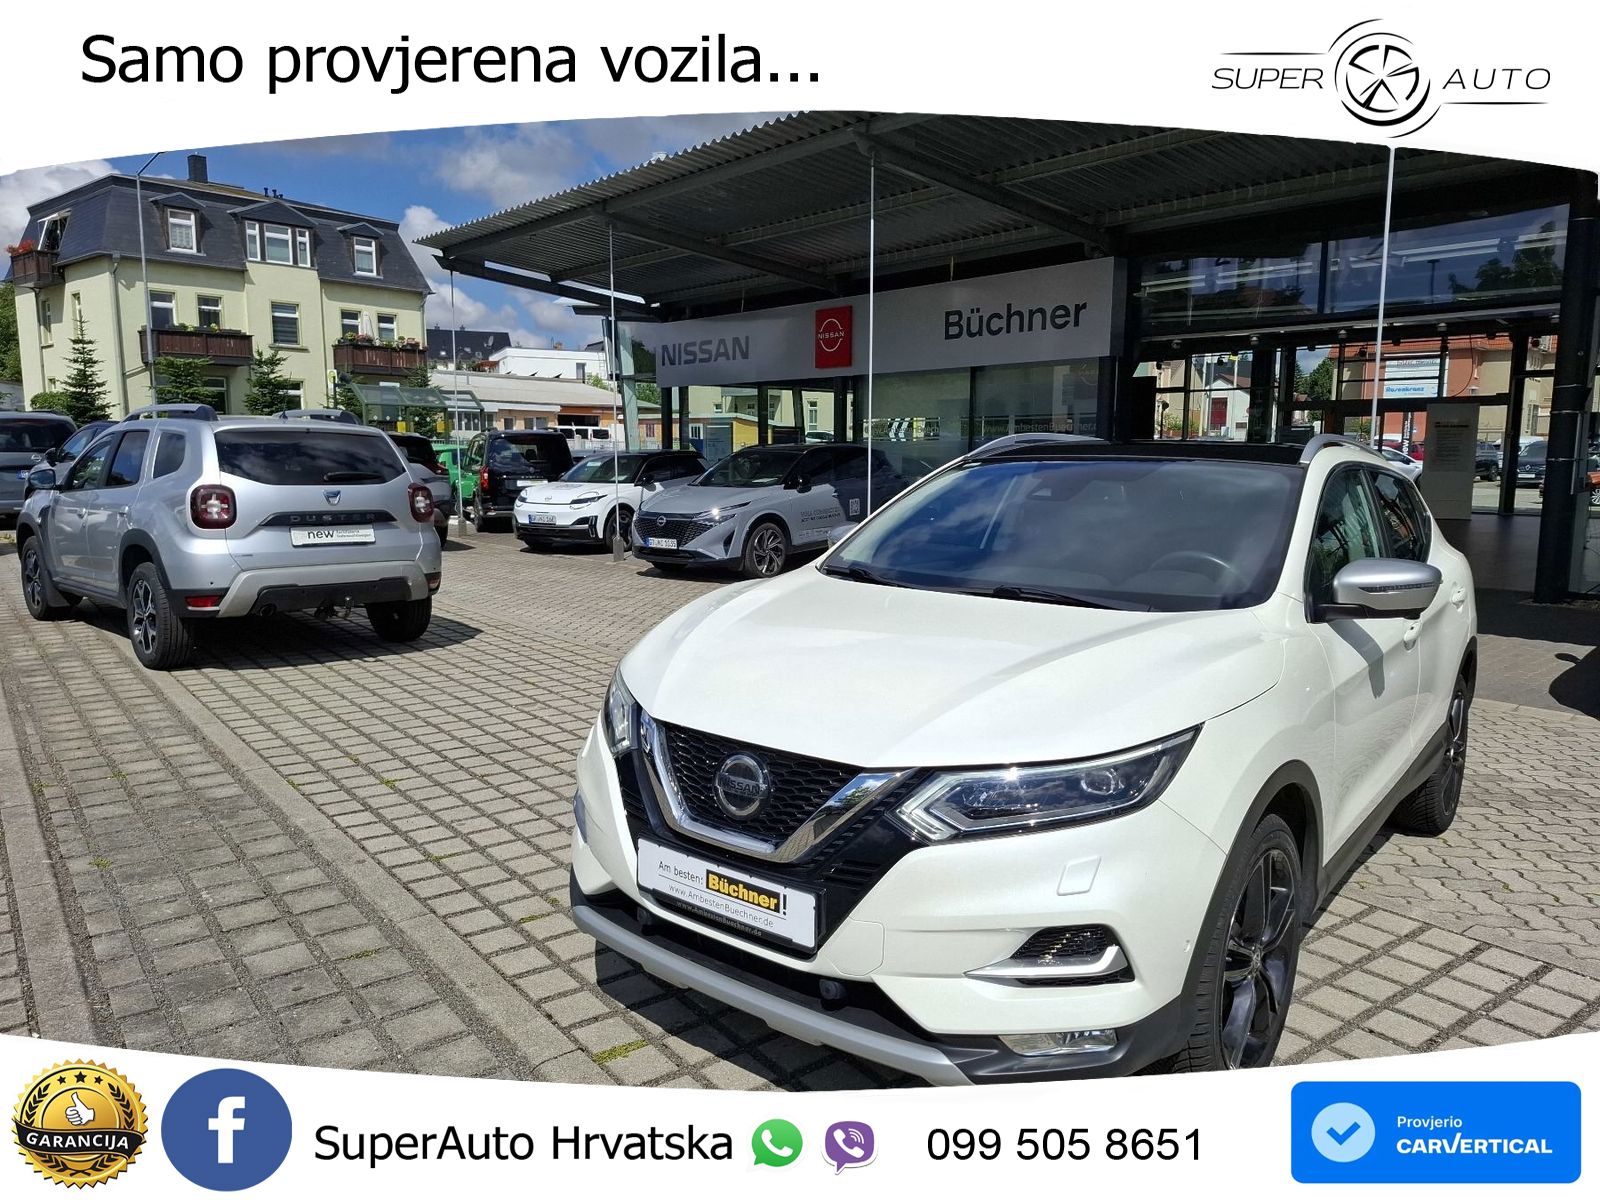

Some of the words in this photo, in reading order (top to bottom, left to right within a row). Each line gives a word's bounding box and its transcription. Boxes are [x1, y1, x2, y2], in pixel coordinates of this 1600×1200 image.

[944, 302, 1088, 340] Büchner
[818, 331, 845, 340] NISSAN
[661, 335, 750, 367] NISSAN
[290, 514, 376, 522] DUSTER
[307, 530, 334, 539] new
[658, 861, 672, 873] Am
[673, 866, 704, 886] besten:
